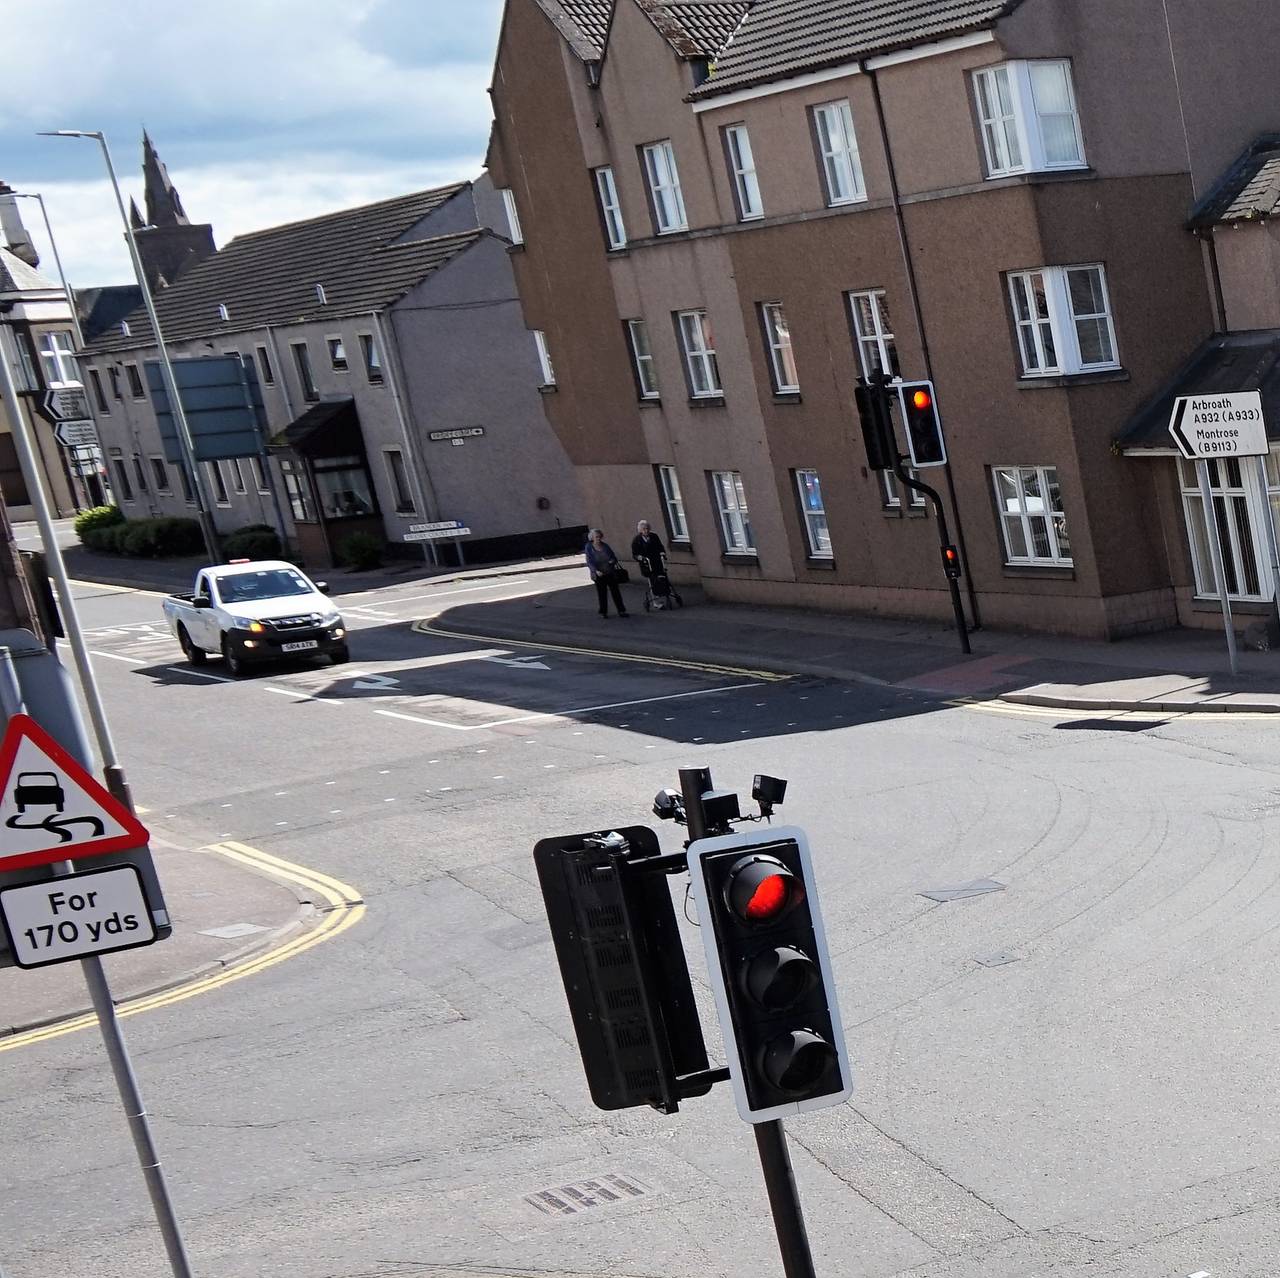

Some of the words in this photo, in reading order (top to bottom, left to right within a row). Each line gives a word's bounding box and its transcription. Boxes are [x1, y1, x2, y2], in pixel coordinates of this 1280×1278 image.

[1192, 398, 1232, 410] Arbroath
[1194, 412, 1220, 423] A932
[1222, 408, 1260, 422] (A933)
[1196, 429, 1239, 439] Montrose
[1198, 440, 1237, 454] (B9113)
[48, 891, 97, 915] For
[24, 920, 79, 950] 170
[85, 911, 139, 943] yds
